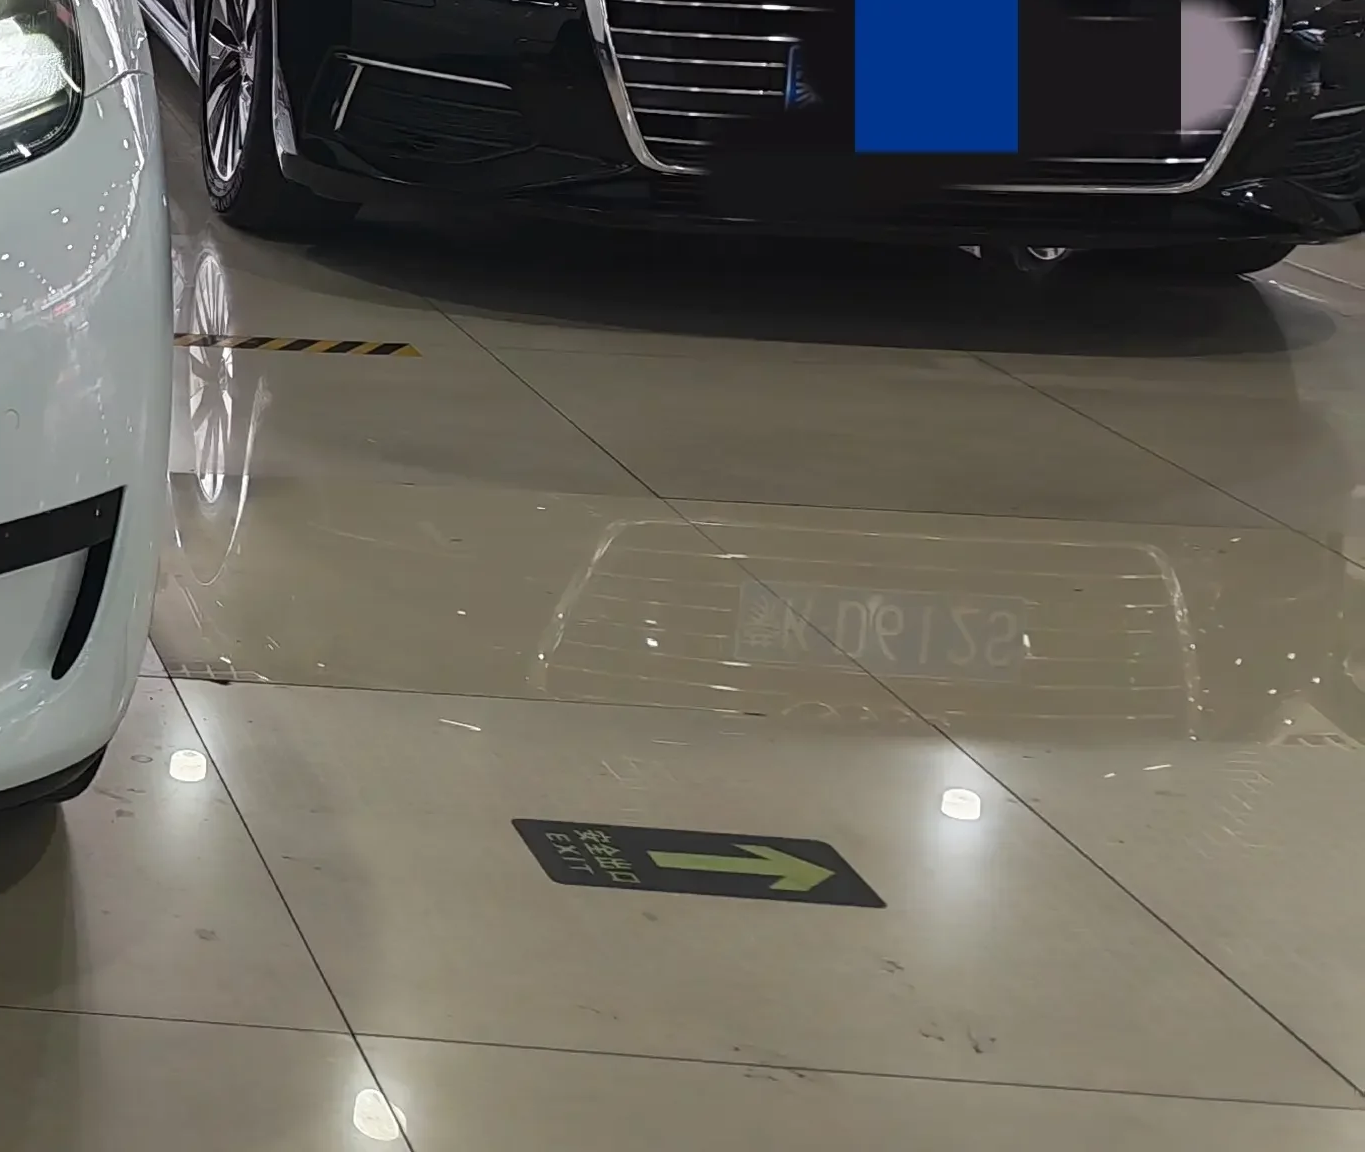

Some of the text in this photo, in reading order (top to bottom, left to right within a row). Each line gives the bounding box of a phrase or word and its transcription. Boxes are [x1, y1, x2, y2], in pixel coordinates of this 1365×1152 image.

[545, 832, 594, 875] EXIT
[573, 829, 641, 883] 安全出口
